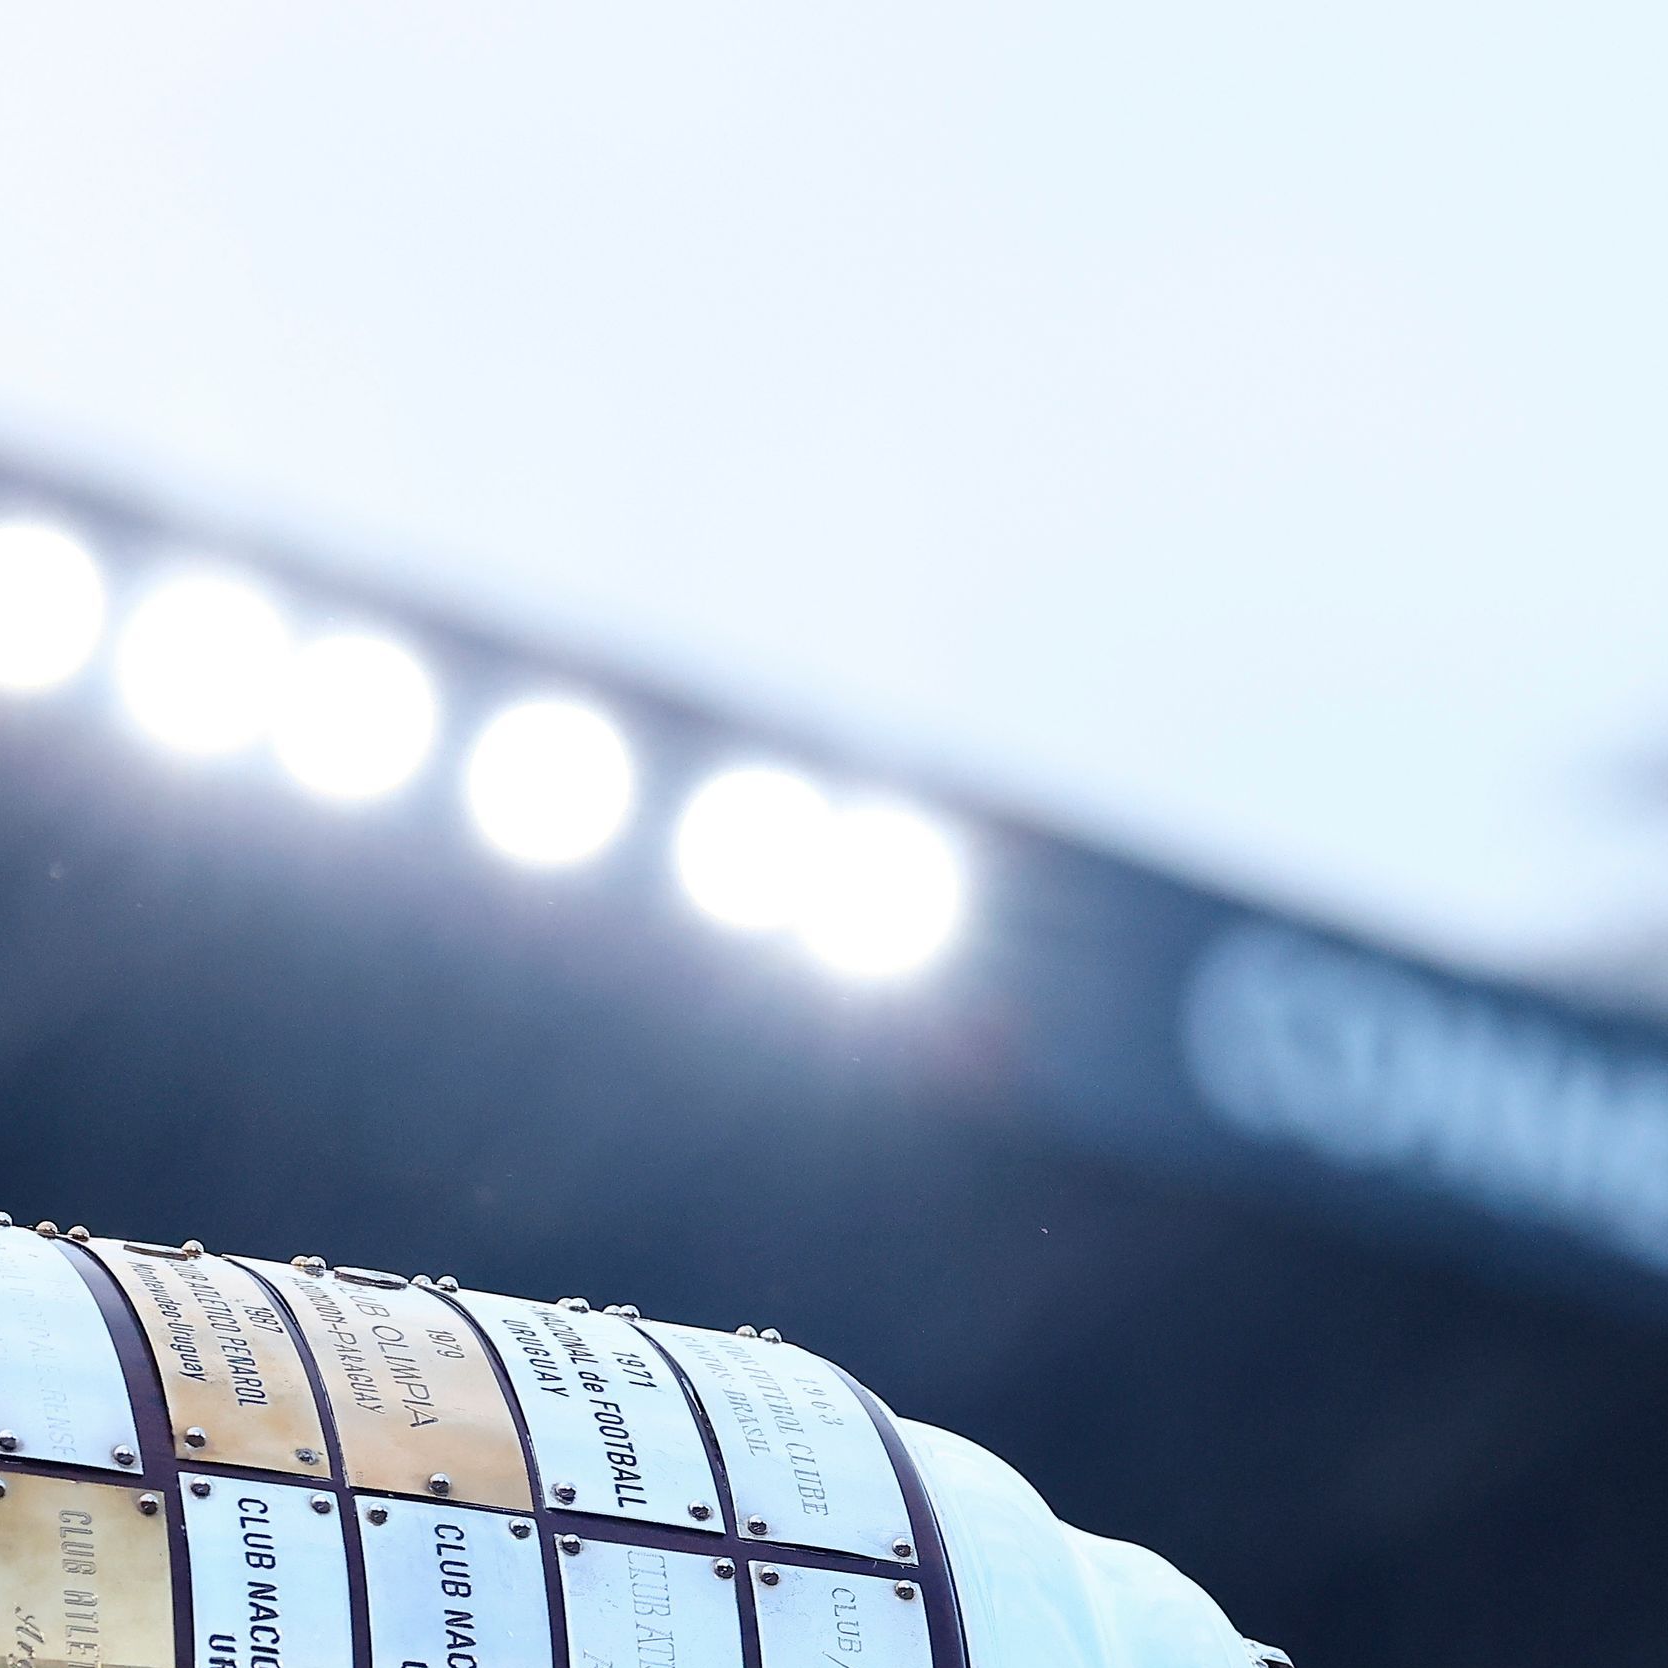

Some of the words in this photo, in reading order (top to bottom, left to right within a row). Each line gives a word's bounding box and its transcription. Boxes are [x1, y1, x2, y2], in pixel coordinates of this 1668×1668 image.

[189, 1280, 241, 1340] ATLETICO
[220, 1334, 268, 1407] PENAROL
[244, 1305, 282, 1335] 1987
[425, 1329, 464, 1360] 1979
[372, 1324, 439, 1428] OLIMPIA
[502, 1318, 569, 1398] URUGUAY
[579, 1371, 601, 1393] de
[611, 1351, 658, 1391] 1971
[722, 1388, 771, 1457] BRASIL
[791, 1377, 844, 1427] 1963
[589, 1398, 648, 1509] FOOTBALL
[786, 1442, 828, 1517] CLUBE
[59, 1509, 97, 1577] CLUB
[238, 1496, 276, 1571] CLUB
[434, 1523, 472, 1600] CLUB
[627, 1549, 672, 1617] CLUB
[831, 1586, 862, 1654] CLUB
